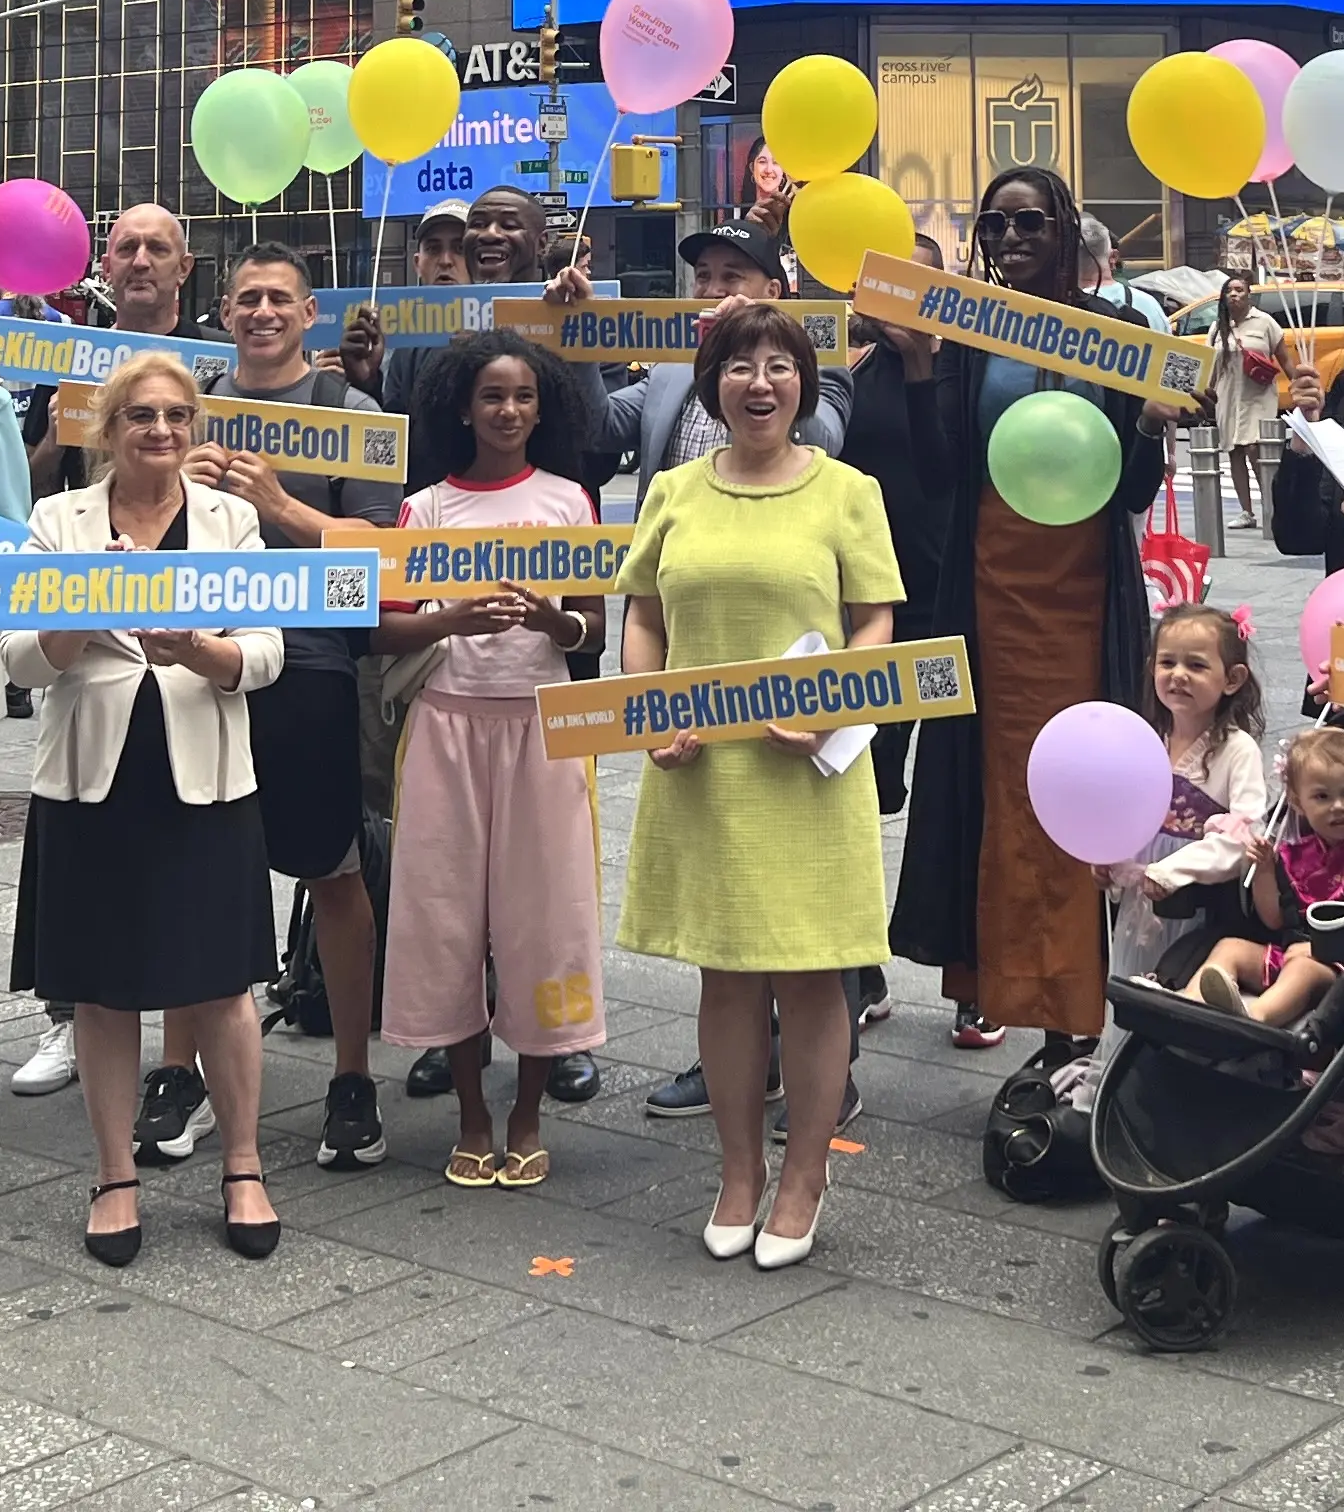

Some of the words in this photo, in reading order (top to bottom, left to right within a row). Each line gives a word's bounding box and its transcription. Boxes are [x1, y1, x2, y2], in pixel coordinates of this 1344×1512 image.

[463, 41, 546, 84] AT&
[882, 62, 917, 73] cross
[920, 60, 952, 72] river
[882, 73, 937, 86] campus
[434, 110, 542, 149] nlimite
[417, 160, 473, 193] data
[561, 308, 700, 350] #BeKindB
[918, 284, 1153, 382] #BeKindBeCool
[206, 414, 349, 463] ndBeCool
[380, 558, 397, 569] RLD
[9, 566, 309, 614] #BeKindBeCool
[623, 661, 902, 736] #BeKindBeCool
